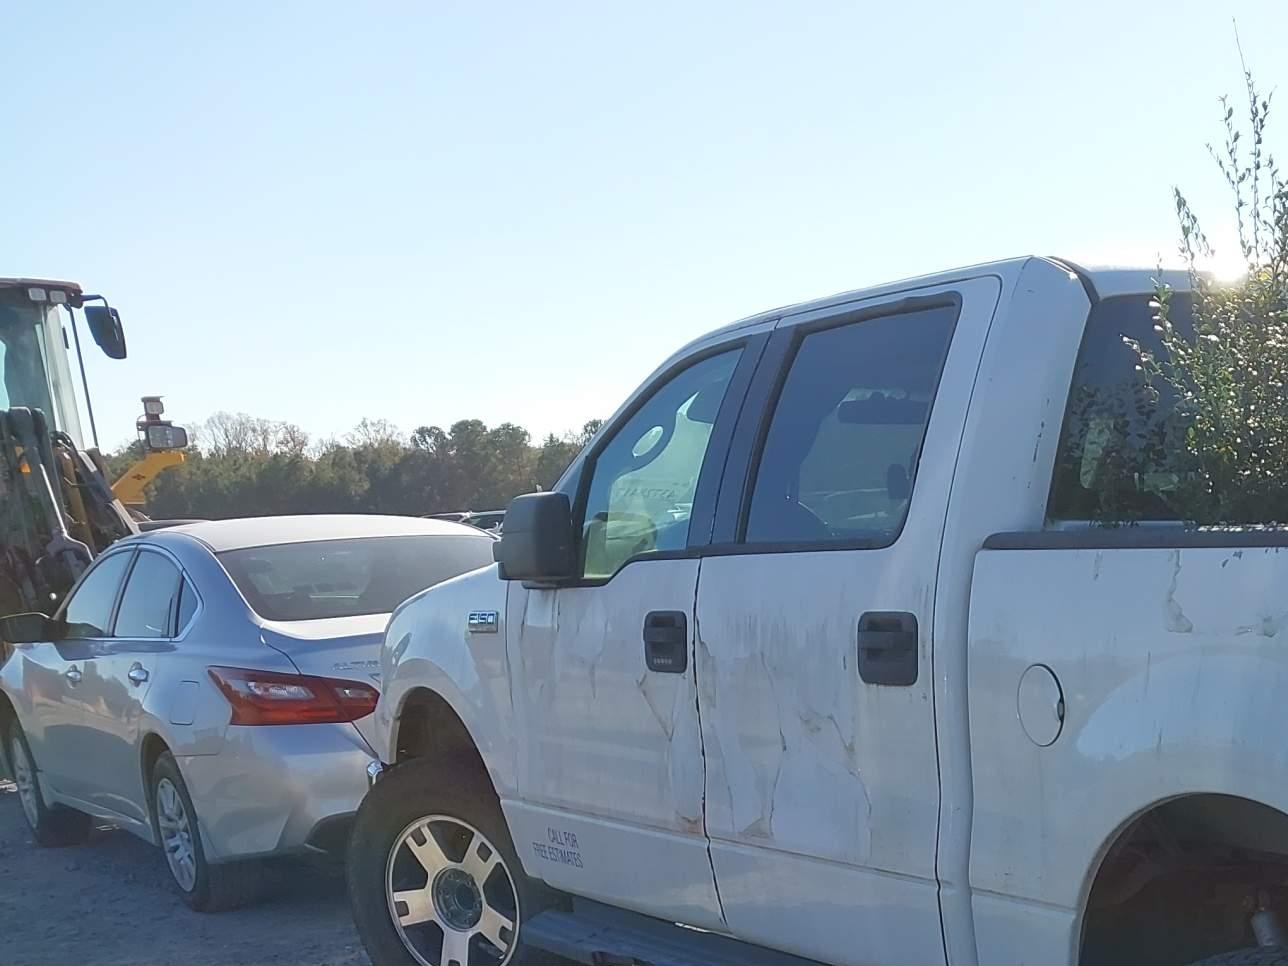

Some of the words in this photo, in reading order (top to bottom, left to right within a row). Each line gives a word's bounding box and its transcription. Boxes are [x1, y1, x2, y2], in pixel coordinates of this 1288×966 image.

[547, 827, 565, 846] CALL
[564, 831, 579, 849] FOR
[533, 842, 549, 861] FREE
[548, 847, 584, 869] ESTIMATES
